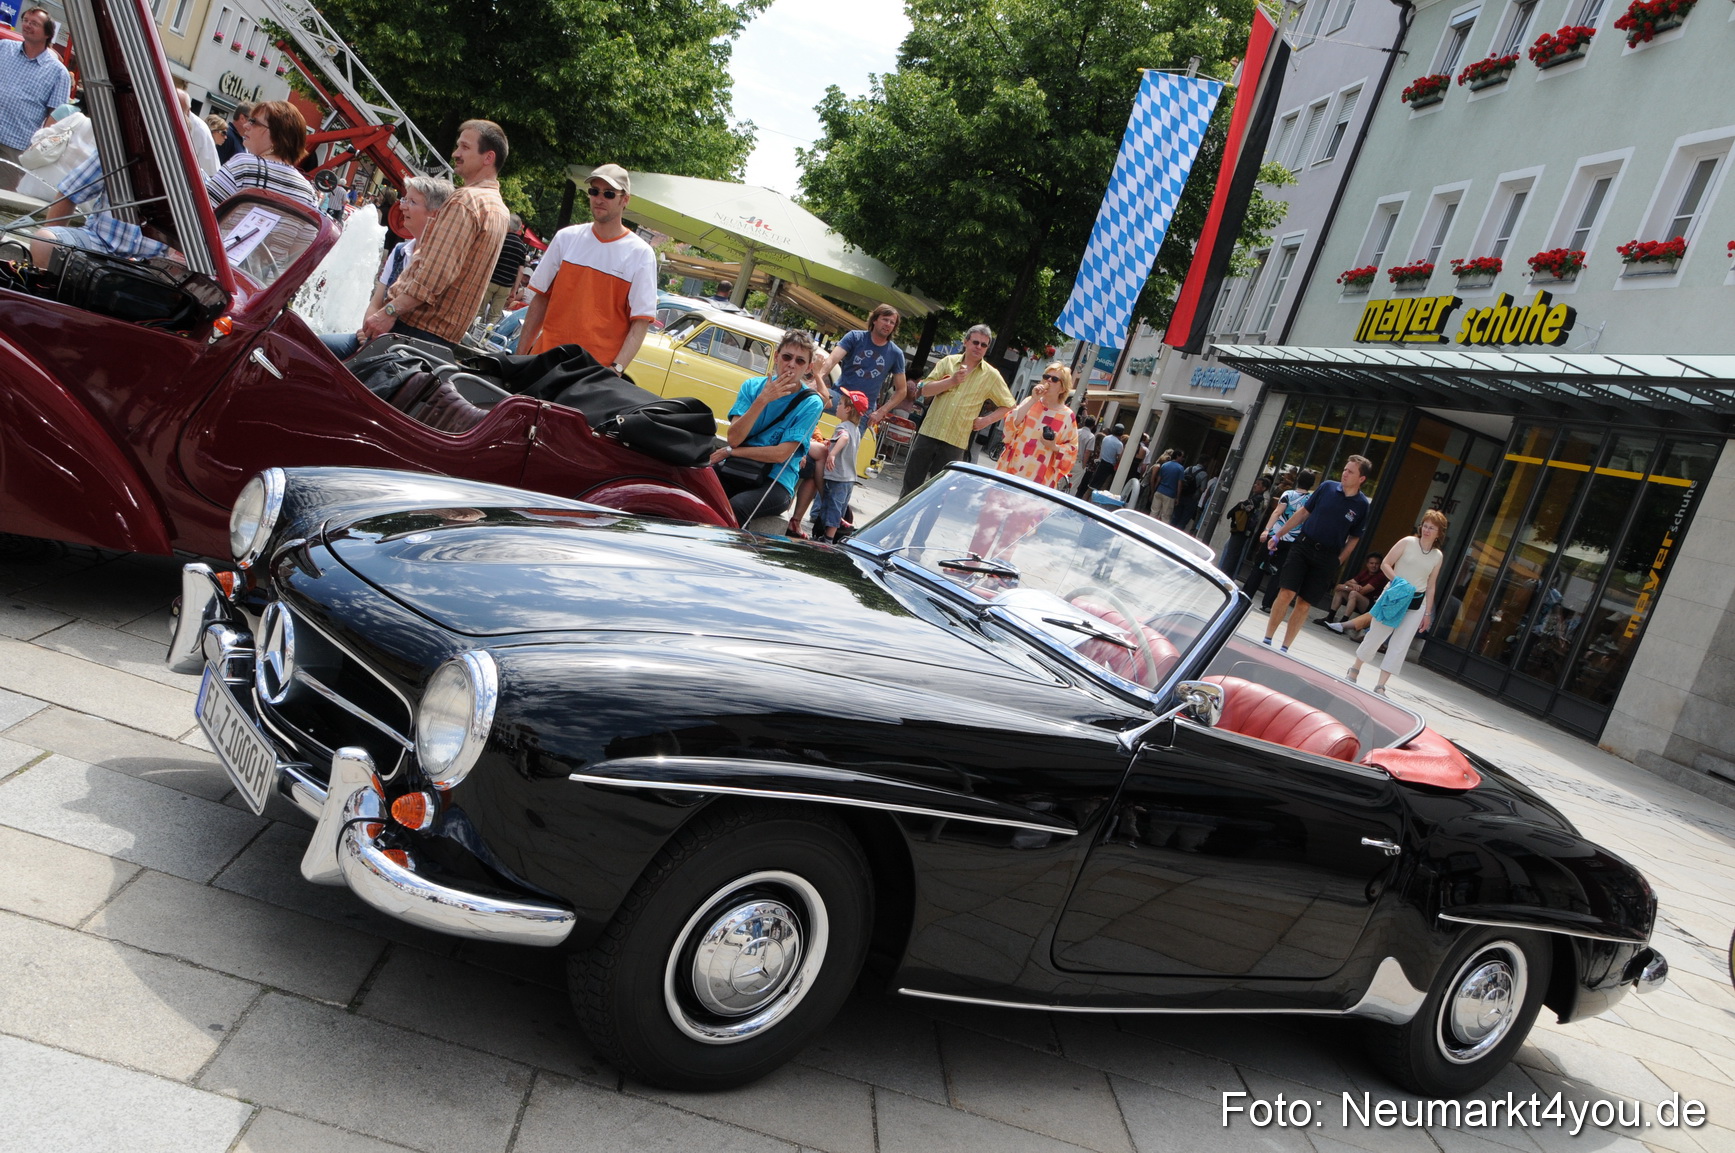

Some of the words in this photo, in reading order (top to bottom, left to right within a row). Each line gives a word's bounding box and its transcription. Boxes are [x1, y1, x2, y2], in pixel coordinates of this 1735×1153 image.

[714, 211, 791, 245] NEUMARKTER
[1353, 295, 1460, 343] mayer
[1455, 289, 1571, 346] schuhe
[1623, 531, 1674, 638] mayer
[1670, 480, 1699, 533] schuhe
